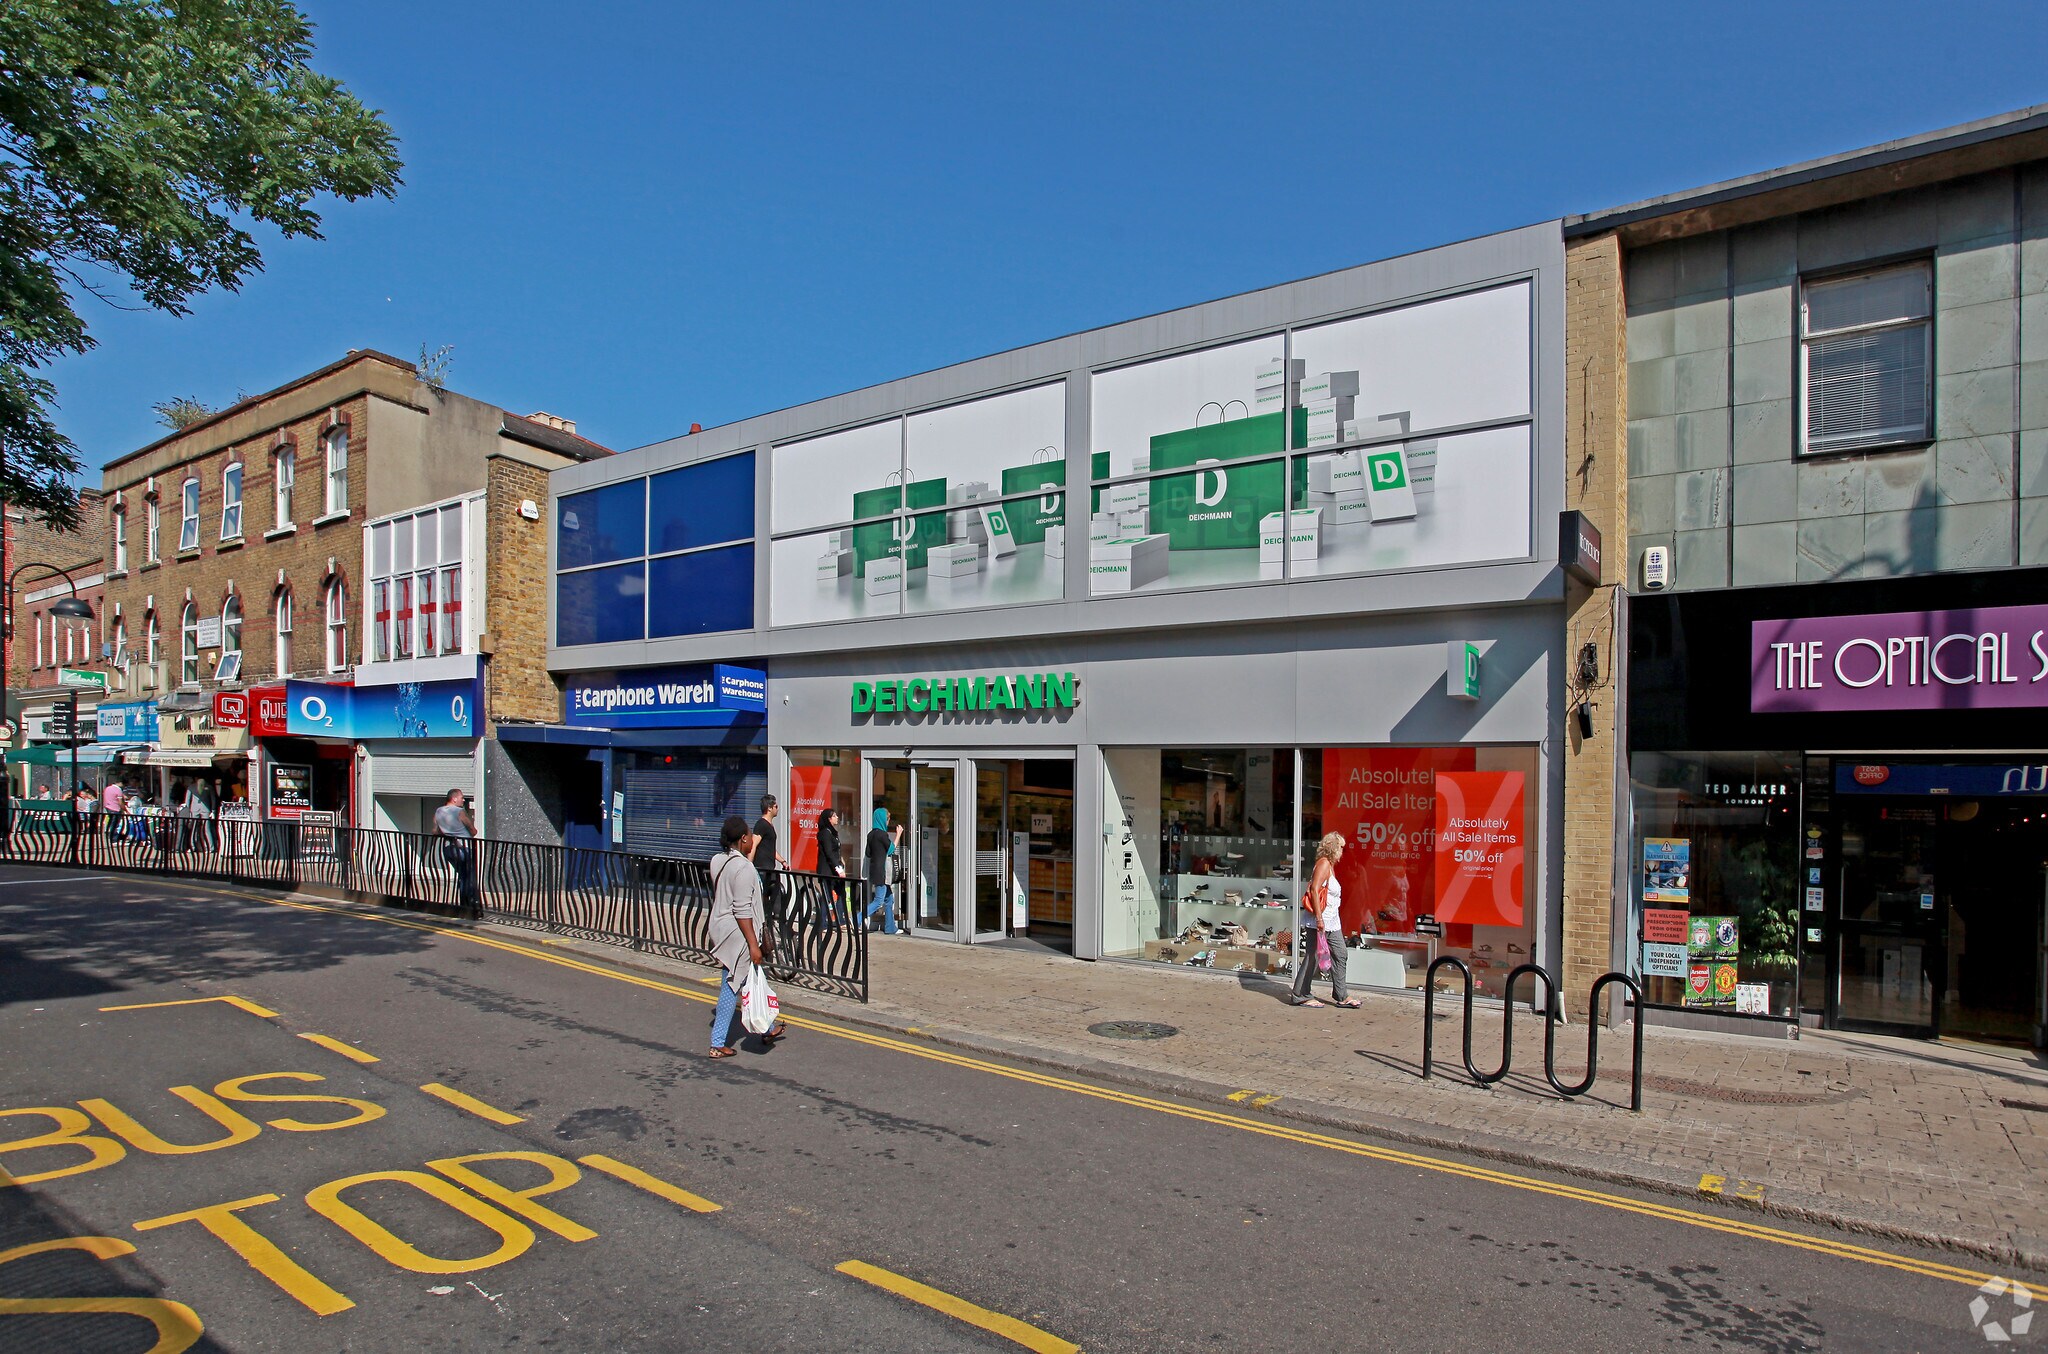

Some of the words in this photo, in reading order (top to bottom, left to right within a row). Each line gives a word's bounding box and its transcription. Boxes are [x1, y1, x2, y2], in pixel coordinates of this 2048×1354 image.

[1256, 370, 1282, 380] DEICHMANN
[1302, 384, 1328, 393] DEICHMANN
[1406, 450, 1436, 458] DEICHMANN
[1374, 460, 1398, 484] D
[1196, 458, 1228, 506] D
[1040, 482, 1060, 514] D
[1036, 516, 1062, 524] DEICHMANN
[1188, 512, 1232, 521] DEICHMANN
[991, 516, 1004, 531] D
[1264, 535, 1314, 544] DEICMANN
[952, 557, 976, 566] DEICHMANN
[1770, 641, 1822, 689] THE
[1834, 632, 2018, 688] OPTICAL
[726, 676, 764, 690] Carphone
[582, 684, 656, 711] Carphone
[658, 680, 714, 705] Wareh
[722, 686, 764, 700] Warehouse
[852, 672, 1076, 713] DEICHMANN
[222, 698, 244, 718] Q
[1705, 784, 1730, 794] TED
[1740, 784, 1786, 795] BAKER
[272, 798, 310, 806] HOURS
[797, 798, 825, 806] Absolutely
[1338, 792, 1358, 808] All
[1362, 792, 1400, 809] Sale
[799, 820, 814, 828] 50%
[1449, 818, 1508, 830] Absolutely
[1356, 822, 1407, 844] 50%
[1410, 828, 1436, 845] off
[1442, 832, 1456, 842] All
[1458, 832, 1482, 842] Sale
[1484, 833, 1516, 844] Items
[1372, 850, 1399, 859] original
[1400, 852, 1420, 860] price
[1454, 849, 1485, 863] 50%
[1487, 852, 1504, 863] off
[0, 1072, 387, 1188] BUS
